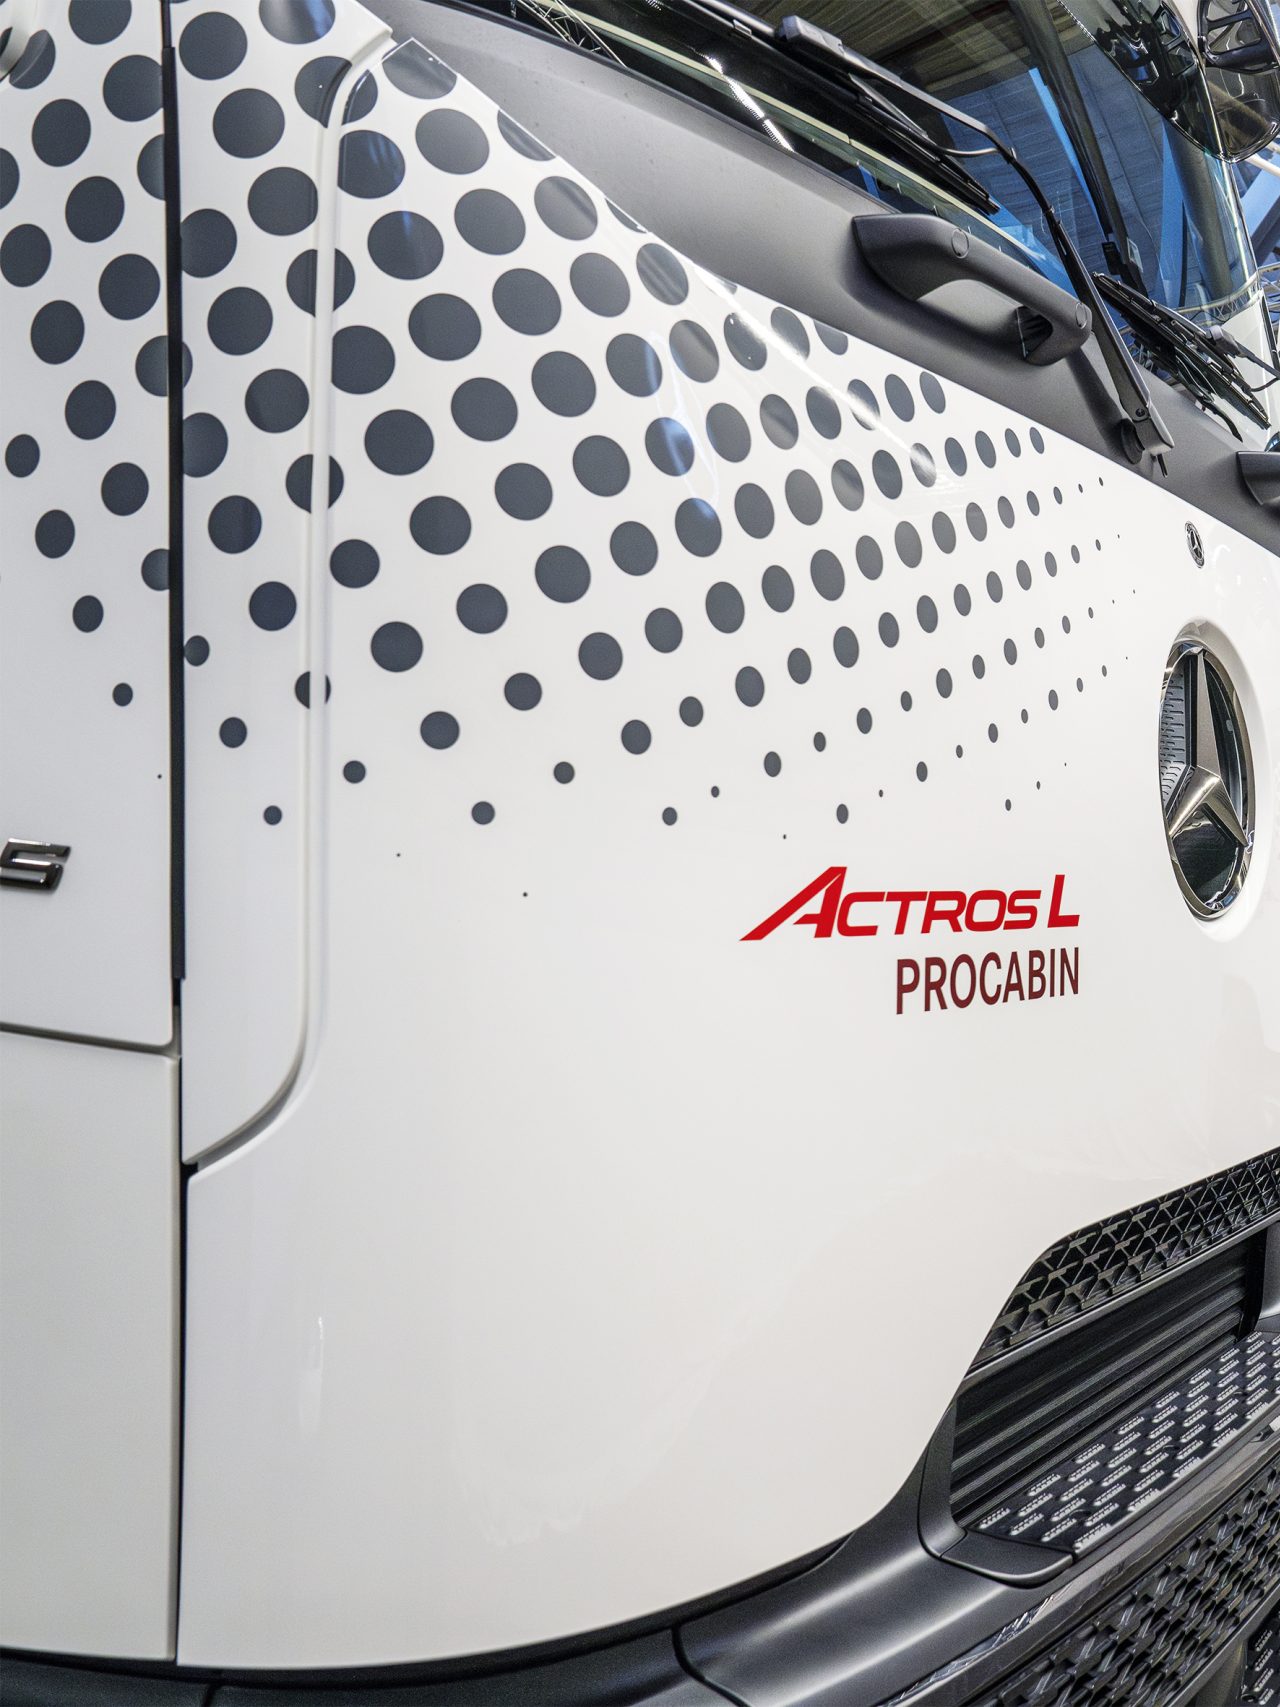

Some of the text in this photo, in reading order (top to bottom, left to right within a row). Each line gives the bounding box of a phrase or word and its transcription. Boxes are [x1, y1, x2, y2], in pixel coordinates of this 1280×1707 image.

[739, 866, 1080, 941] ACTROS L
[896, 947, 1080, 1015] PROCABIN
